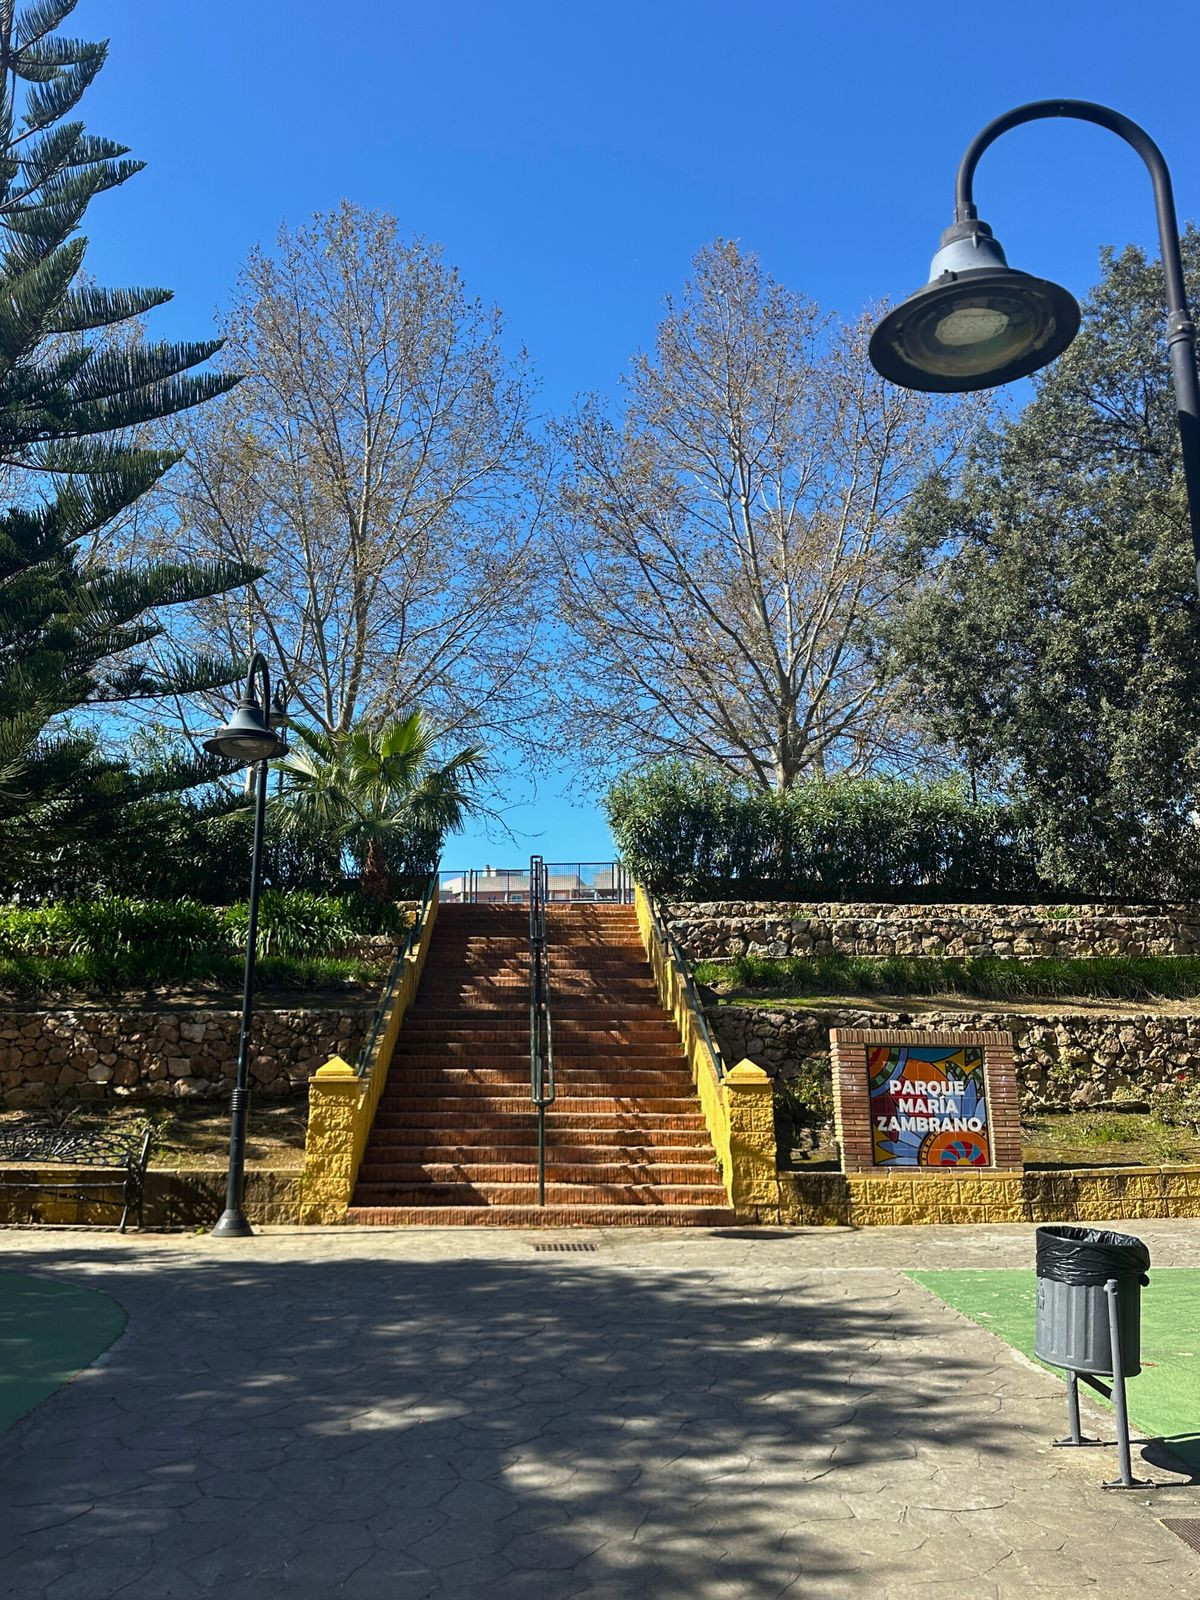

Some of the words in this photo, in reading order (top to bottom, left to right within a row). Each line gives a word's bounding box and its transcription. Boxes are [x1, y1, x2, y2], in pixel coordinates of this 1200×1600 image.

[889, 1080, 965, 1097] PARQUE
[898, 1096, 959, 1114] MARÍA
[877, 1116, 982, 1132] ZAMBRANO
